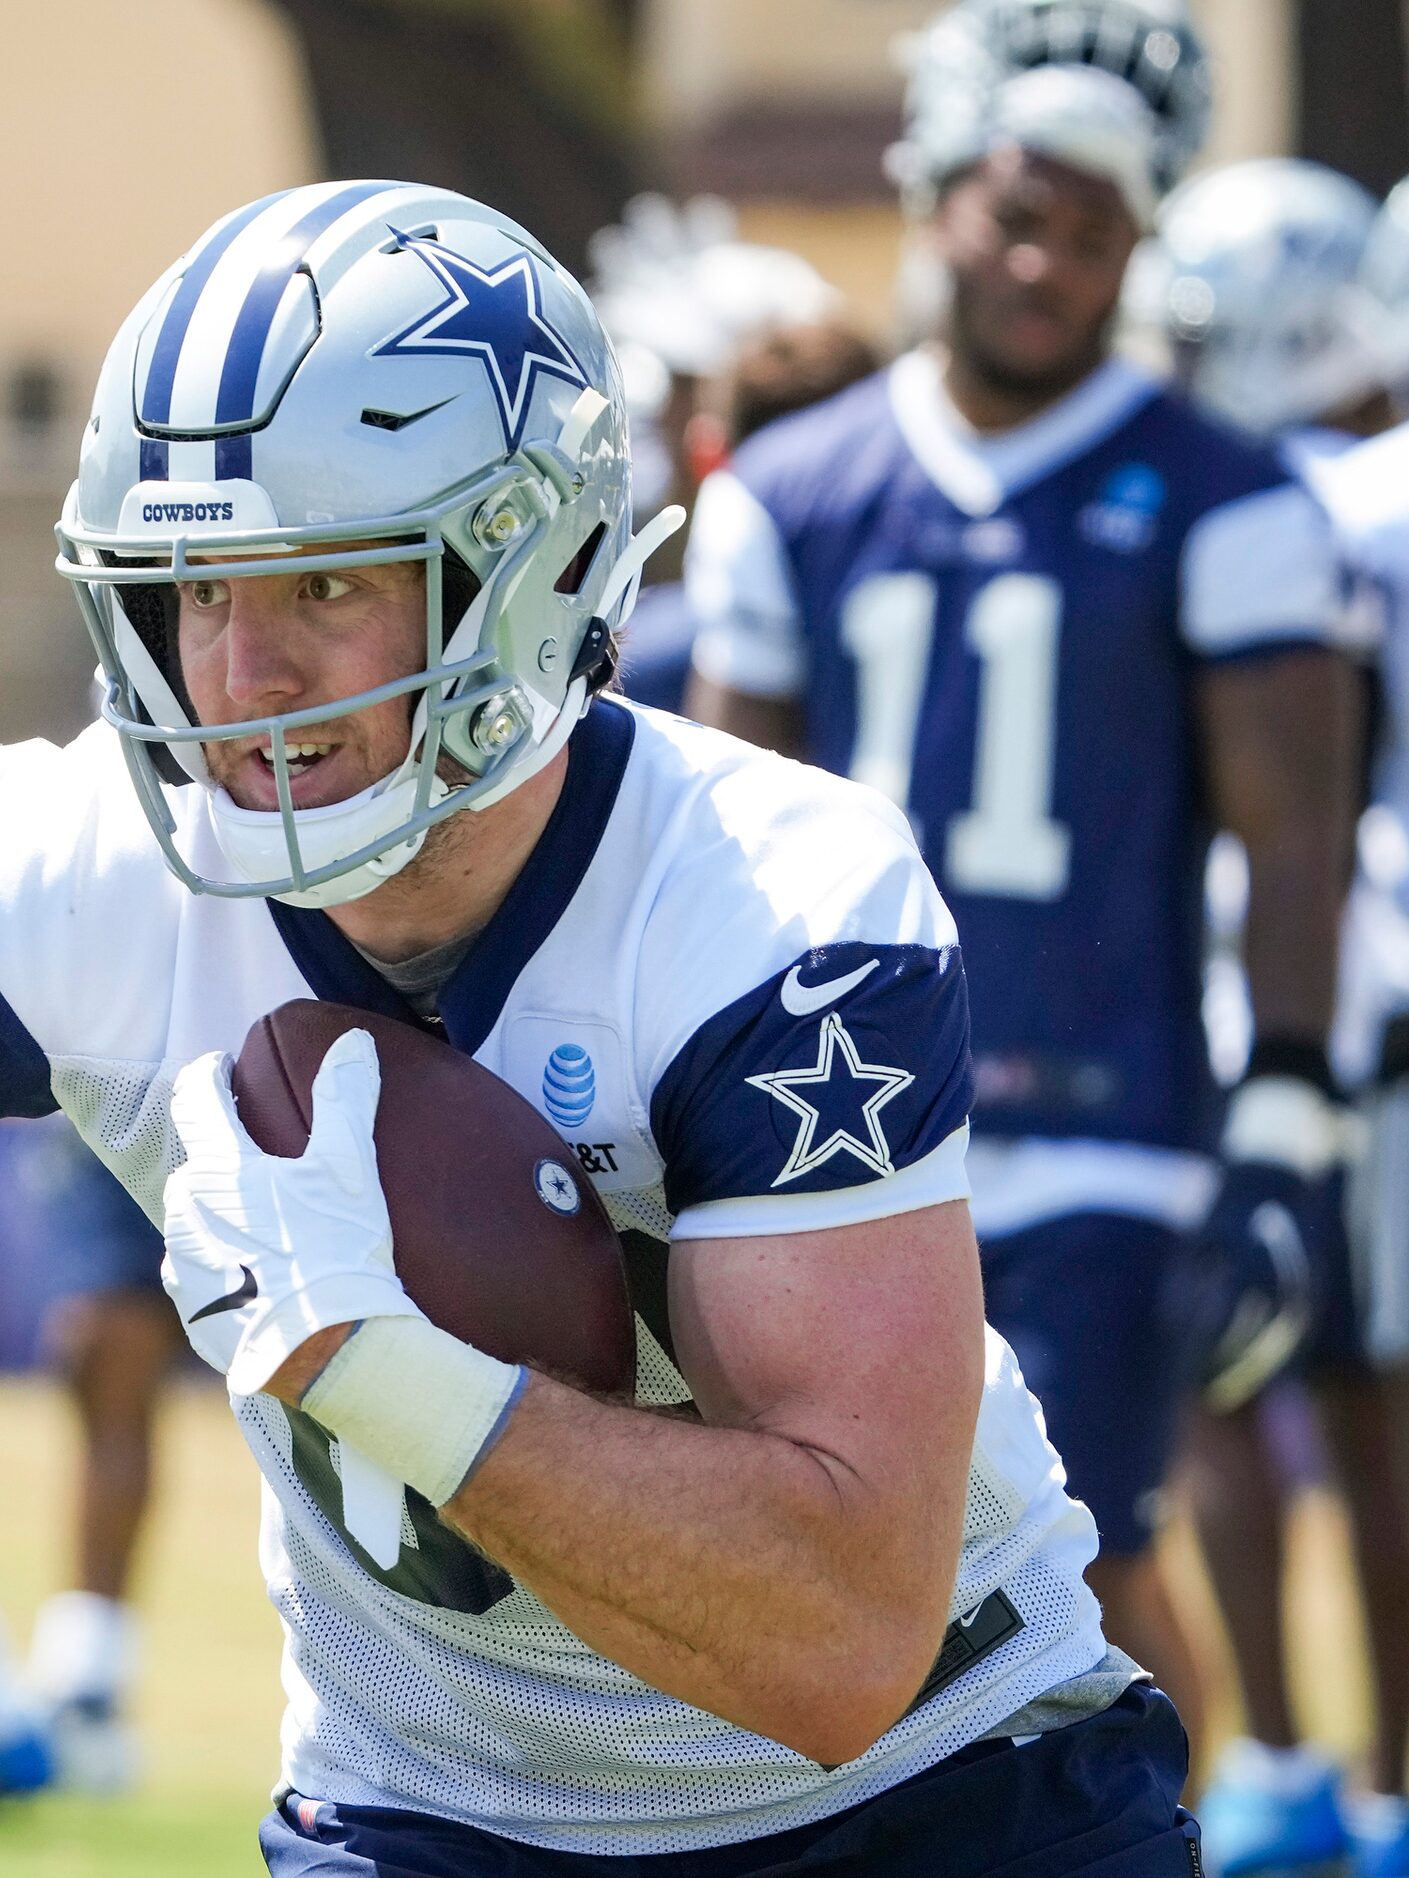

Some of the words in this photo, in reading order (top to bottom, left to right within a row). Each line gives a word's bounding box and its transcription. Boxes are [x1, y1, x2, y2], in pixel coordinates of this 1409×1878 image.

[143, 502, 233, 522] COWBOYS
[842, 571, 1073, 901] 11
[567, 1142, 619, 1174] &T
